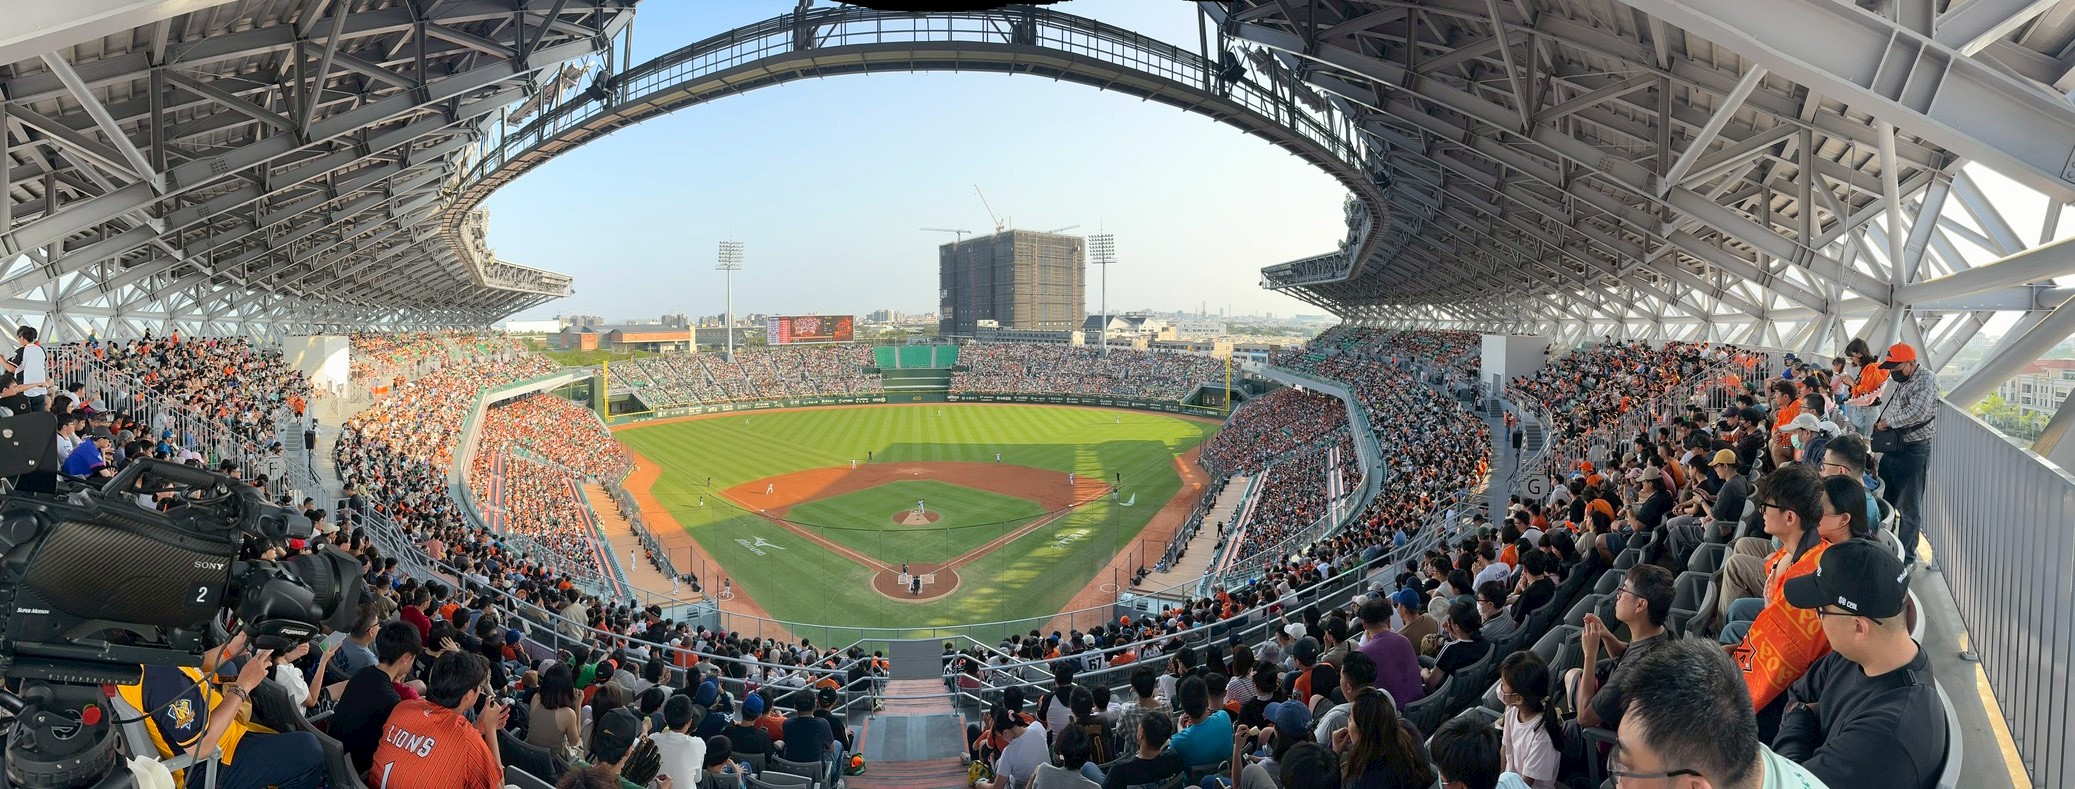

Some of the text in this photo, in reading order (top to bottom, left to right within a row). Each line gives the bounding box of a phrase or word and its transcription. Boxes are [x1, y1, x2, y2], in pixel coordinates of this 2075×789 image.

[269, 461, 278, 476] F
[1527, 478, 1541, 495] G
[193, 561, 224, 571] SONY
[195, 586, 208, 603] 2
[1088, 658, 1102, 670] 67
[386, 724, 436, 759] LIONS
